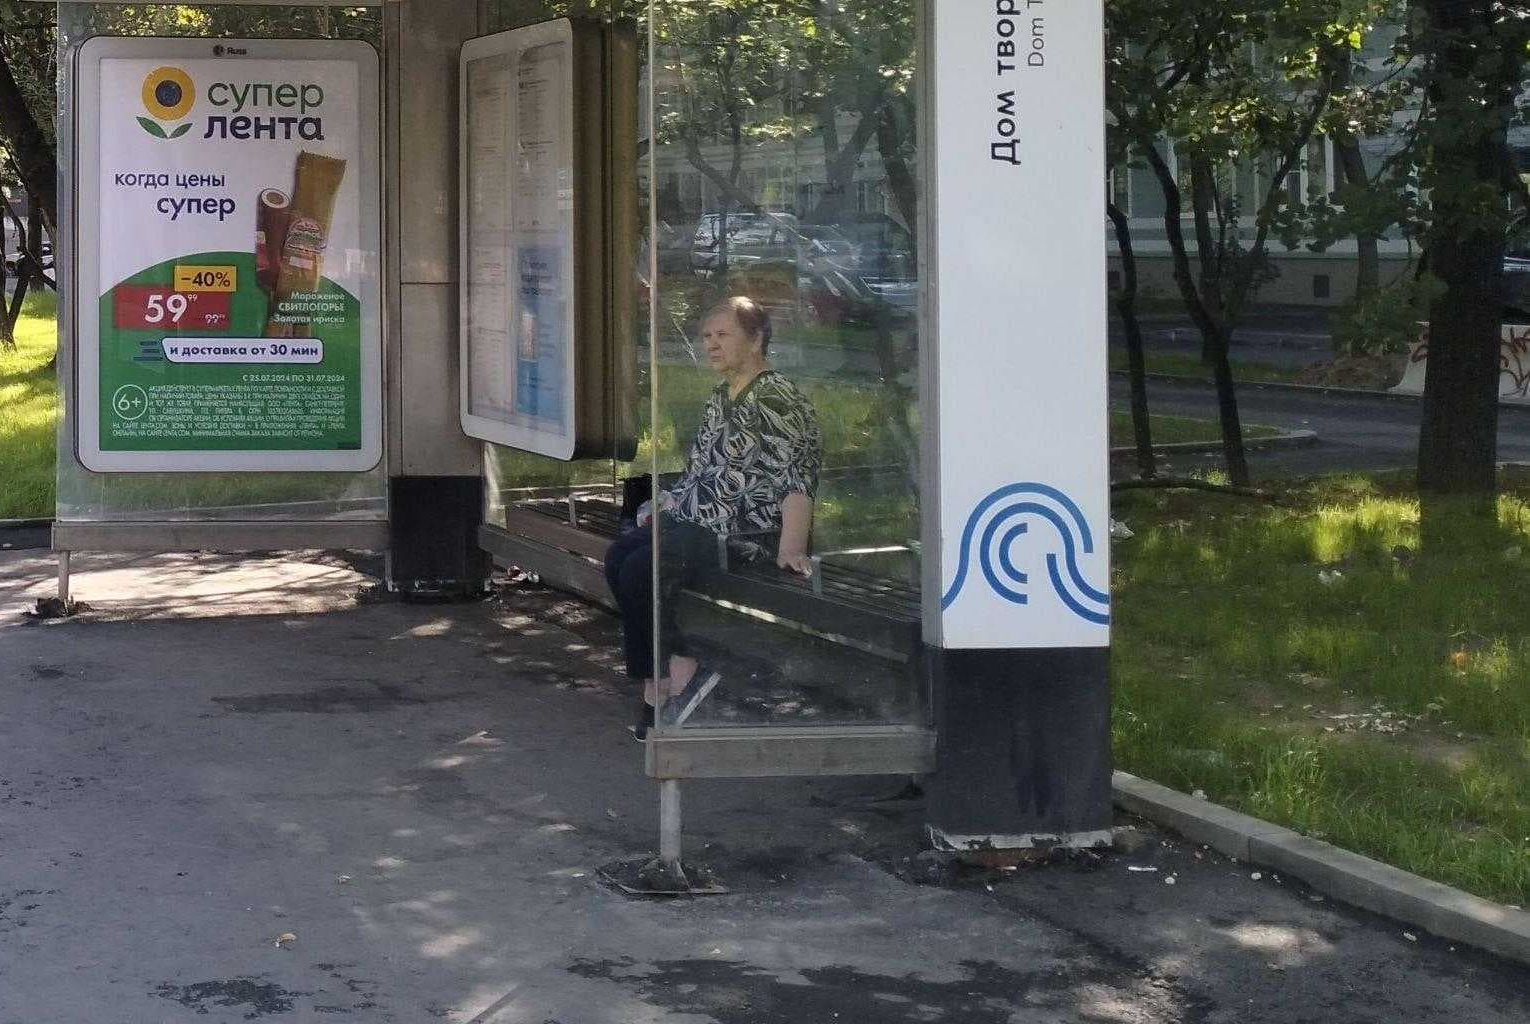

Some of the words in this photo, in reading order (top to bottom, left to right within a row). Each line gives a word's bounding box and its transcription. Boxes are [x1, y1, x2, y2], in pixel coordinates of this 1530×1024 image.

[1027, 17, 1045, 67] Dom
[207, 81, 324, 113] супер
[203, 114, 324, 141] лента
[990, 89, 1021, 166] Дом
[115, 171, 169, 189] когда
[175, 174, 226, 189] цены
[157, 196, 236, 220] супер
[144, 294, 187, 323] 59
[169, 347, 178, 356] и
[181, 347, 247, 357] доставка
[250, 347, 267, 356] от
[270, 344, 287, 356] 30
[290, 347, 319, 356] мин
[117, 393, 143, 411] 6+
